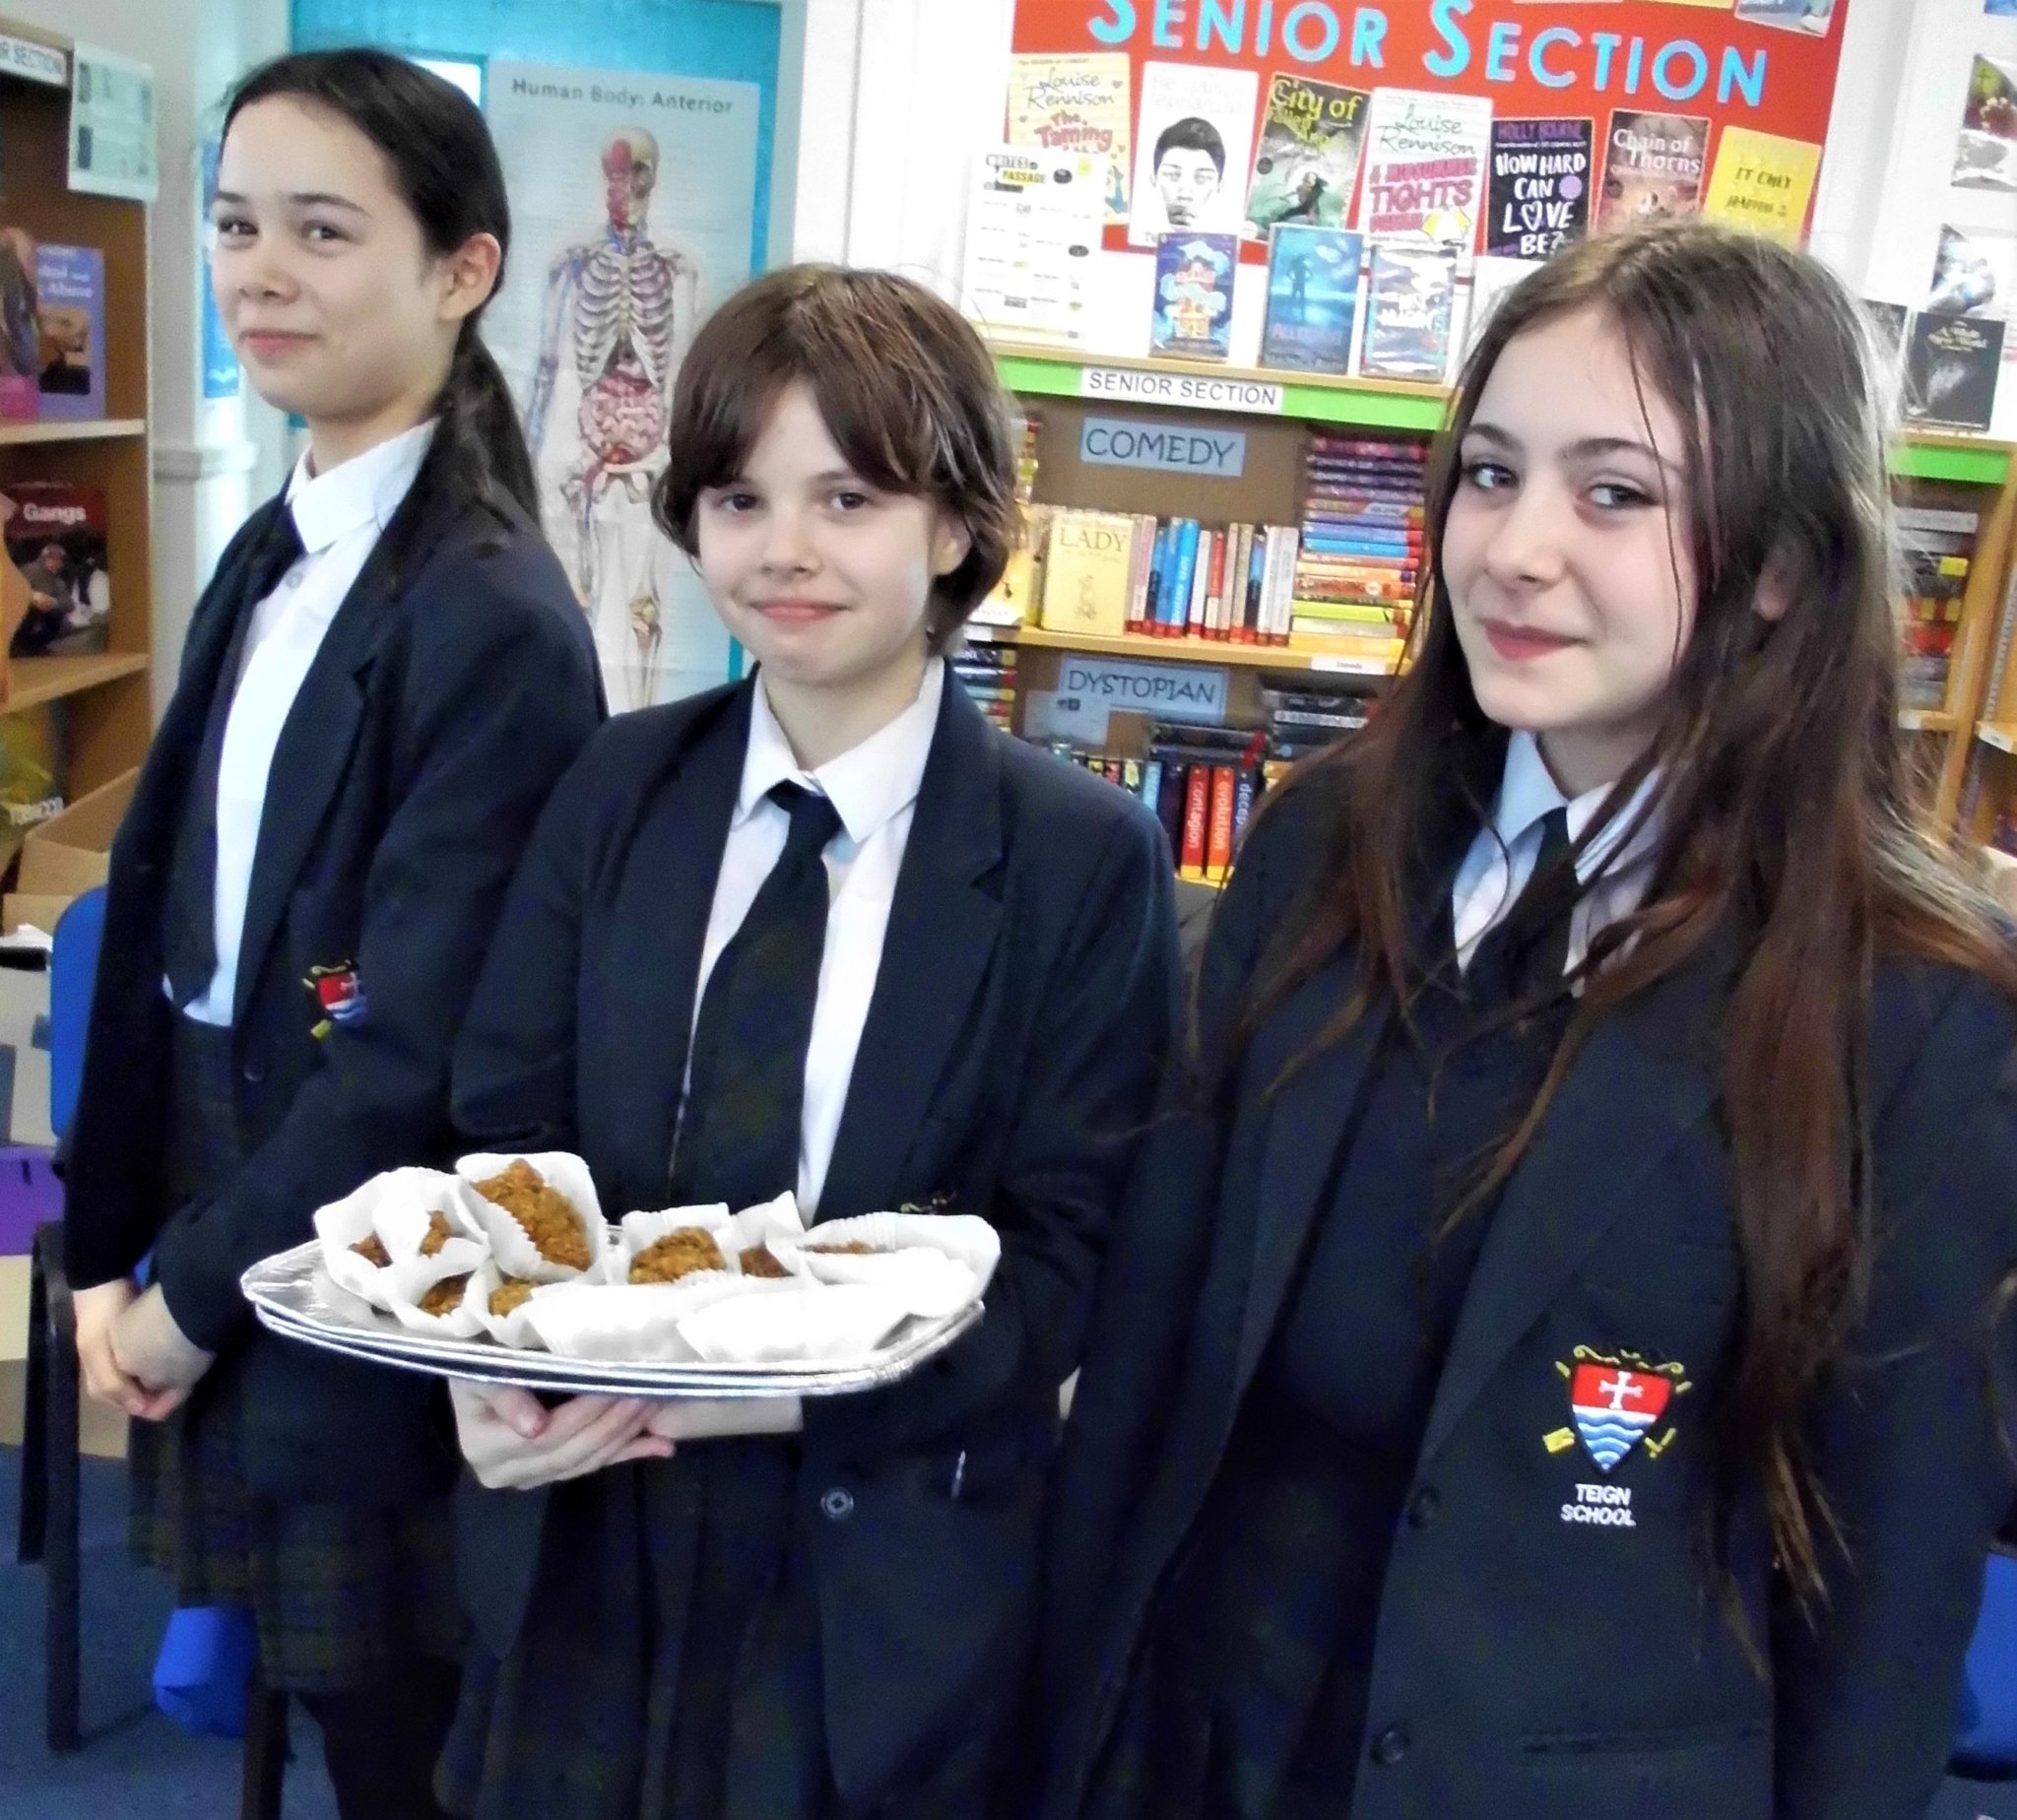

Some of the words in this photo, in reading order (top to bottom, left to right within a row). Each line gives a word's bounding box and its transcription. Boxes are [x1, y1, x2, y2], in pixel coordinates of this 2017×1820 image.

[1087, 0, 1390, 69] SENIOR
[1422, 0, 1768, 107] SECTION
[1039, 66, 1102, 94] Louise
[511, 78, 583, 100] Human
[651, 91, 735, 114] Anterior
[1023, 86, 1115, 111] Rennison
[1271, 79, 1324, 121] City
[1329, 95, 1363, 121] of
[1395, 103, 1464, 136] Louise
[1033, 122, 1114, 153] Taming
[1376, 125, 1476, 156] Rennison
[1612, 128, 1667, 152] Chain
[1669, 134, 1694, 154] of
[1495, 152, 1538, 176] HOW
[1539, 152, 1588, 175] HARD
[1628, 148, 1703, 175] Thorns
[1735, 166, 1755, 181] IT
[1002, 169, 1047, 184] PASSAGE
[1514, 177, 1555, 200] CAN
[1369, 178, 1473, 214] TIGHTS
[1520, 230, 1567, 255] BE?
[1088, 371, 1175, 399] SENIOR
[1179, 378, 1278, 407] SECTION
[1084, 425, 1237, 470] COMEDY
[23, 502, 88, 526] Gangs
[1059, 527, 1129, 552] LADY
[1068, 669, 1217, 705] DYSTOPIAN
[1187, 781, 1204, 849] contagion
[1213, 781, 1231, 850] evolution
[1574, 1482, 1632, 1507] TEIGN
[1560, 1504, 1638, 1528] SCHOOL
